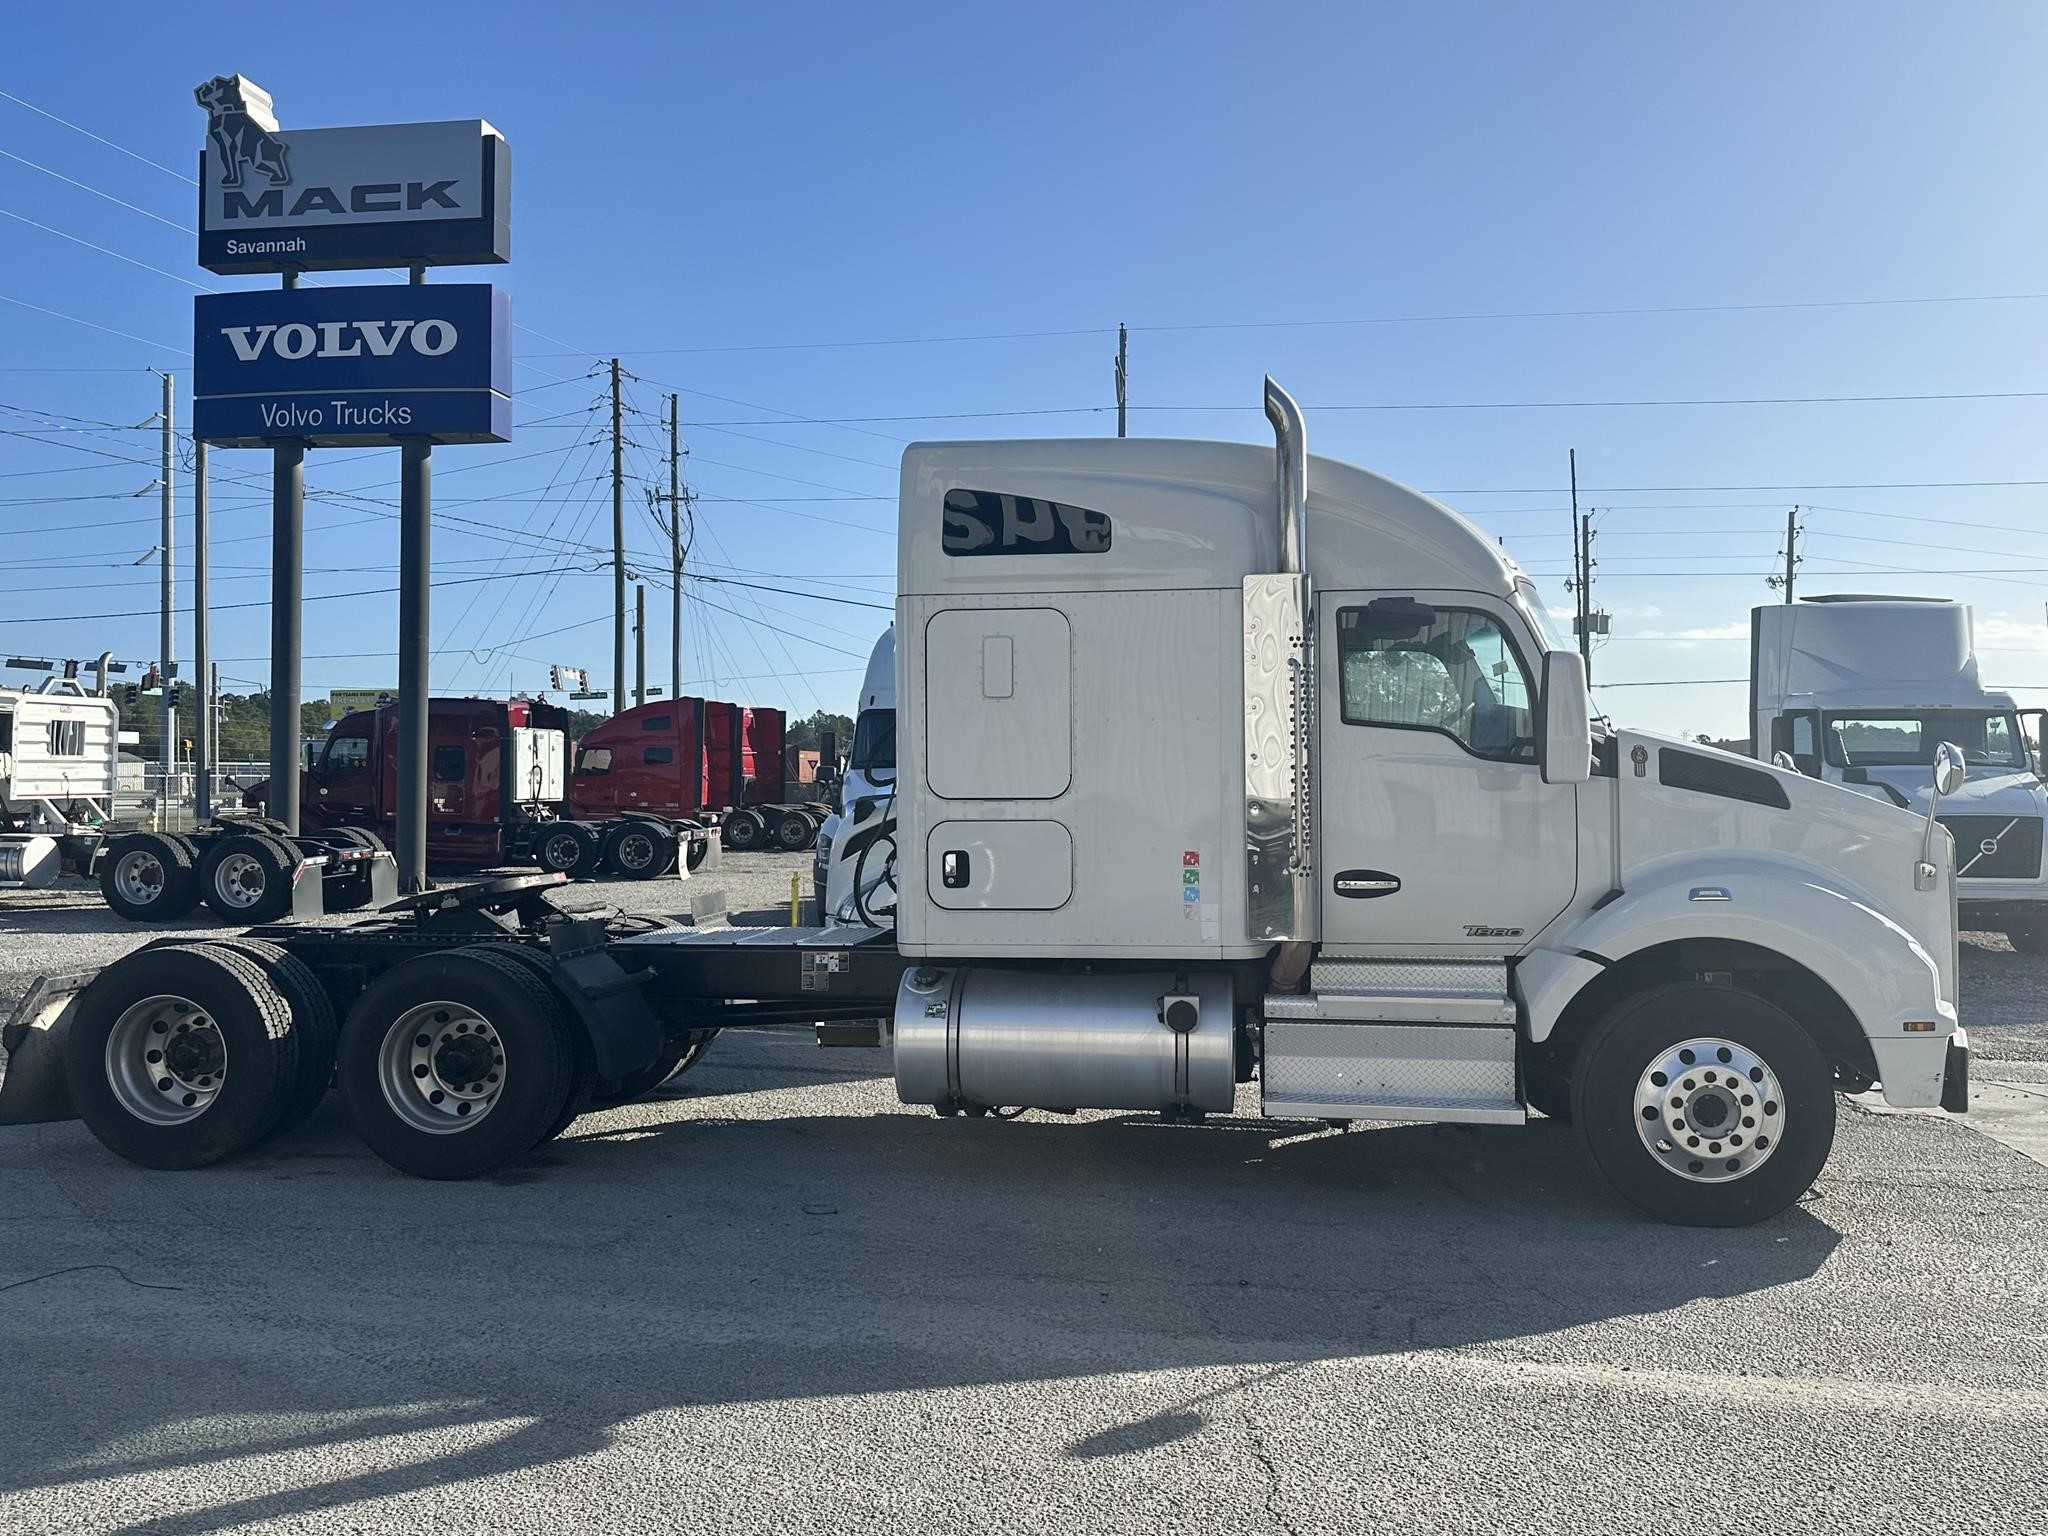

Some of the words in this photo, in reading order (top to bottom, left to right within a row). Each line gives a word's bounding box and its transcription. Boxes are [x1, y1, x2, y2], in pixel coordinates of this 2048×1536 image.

[223, 179, 461, 219] MACK
[226, 236, 307, 255] Savannah
[220, 319, 458, 362] VOLVO
[260, 402, 324, 428] Volvo
[330, 400, 413, 426] Trucks
